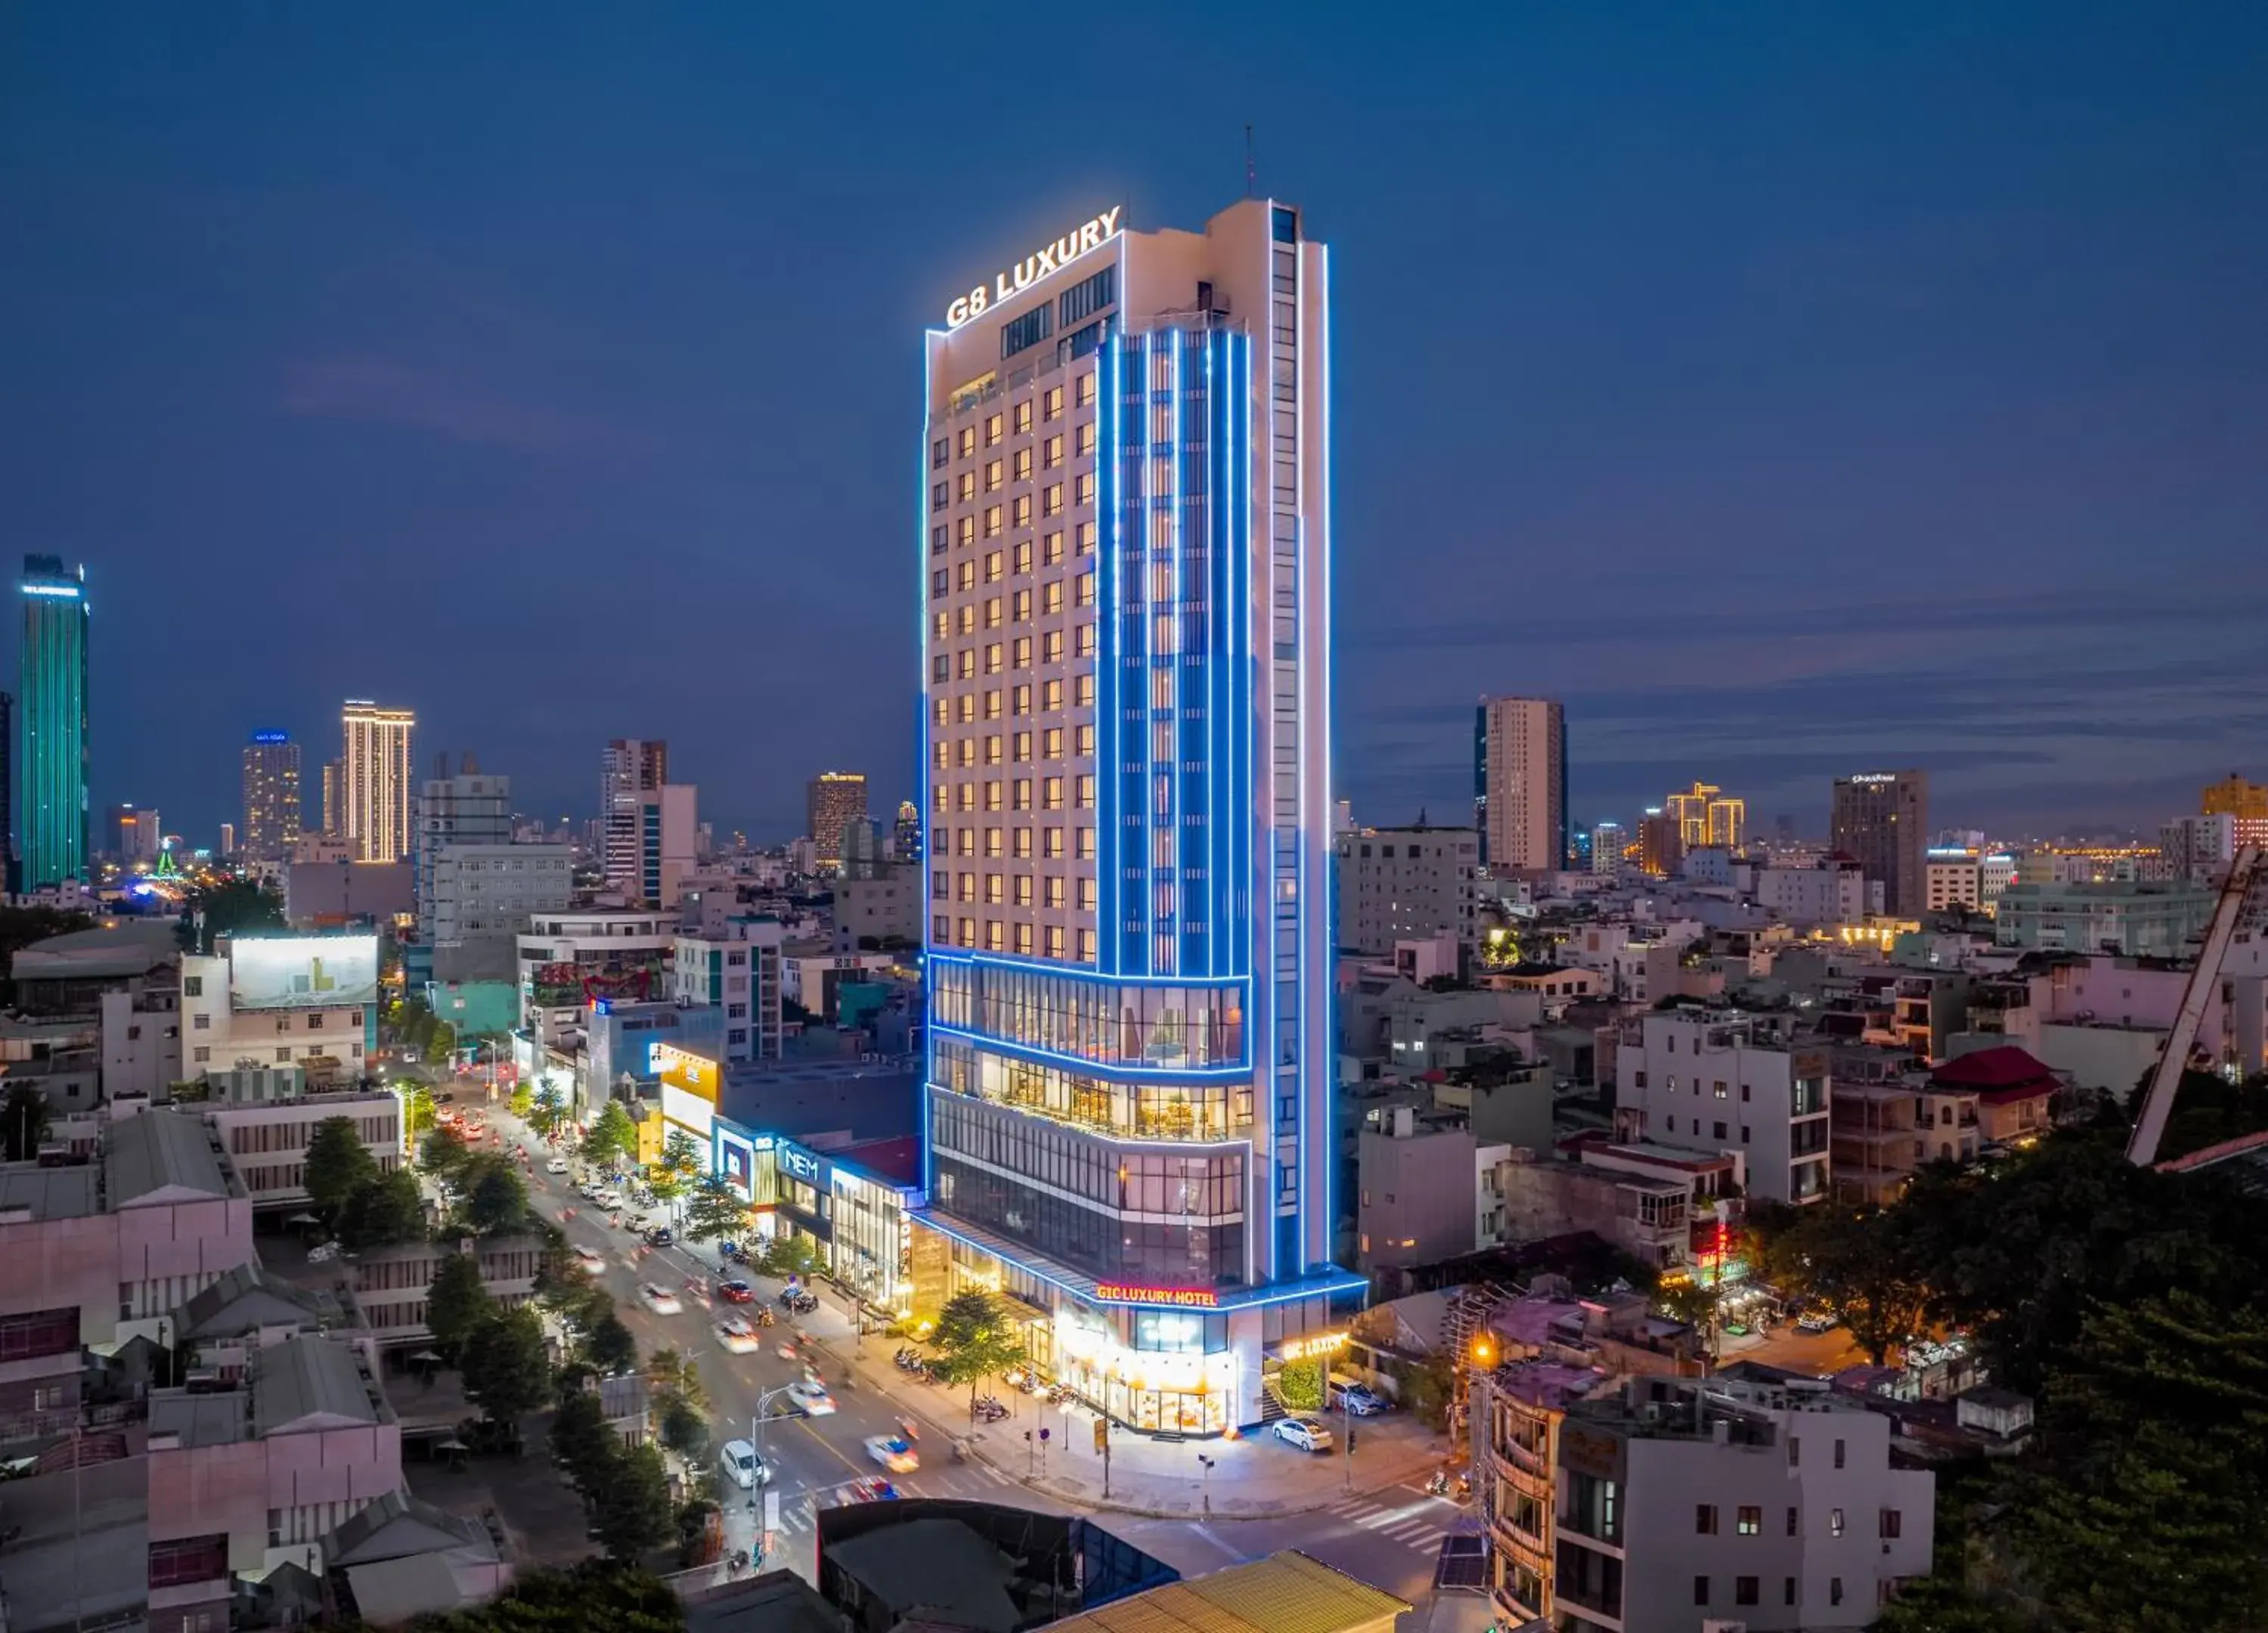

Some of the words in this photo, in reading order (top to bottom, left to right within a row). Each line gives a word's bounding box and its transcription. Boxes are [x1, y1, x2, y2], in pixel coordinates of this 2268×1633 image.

[947, 286, 987, 327] G8
[996, 206, 1121, 301] LUXURY
[785, 1148, 819, 1181] NEM
[1097, 1285, 1121, 1300] GIC
[1122, 1287, 1174, 1302] LUXURY
[1175, 1291, 1218, 1306] HOTEL
